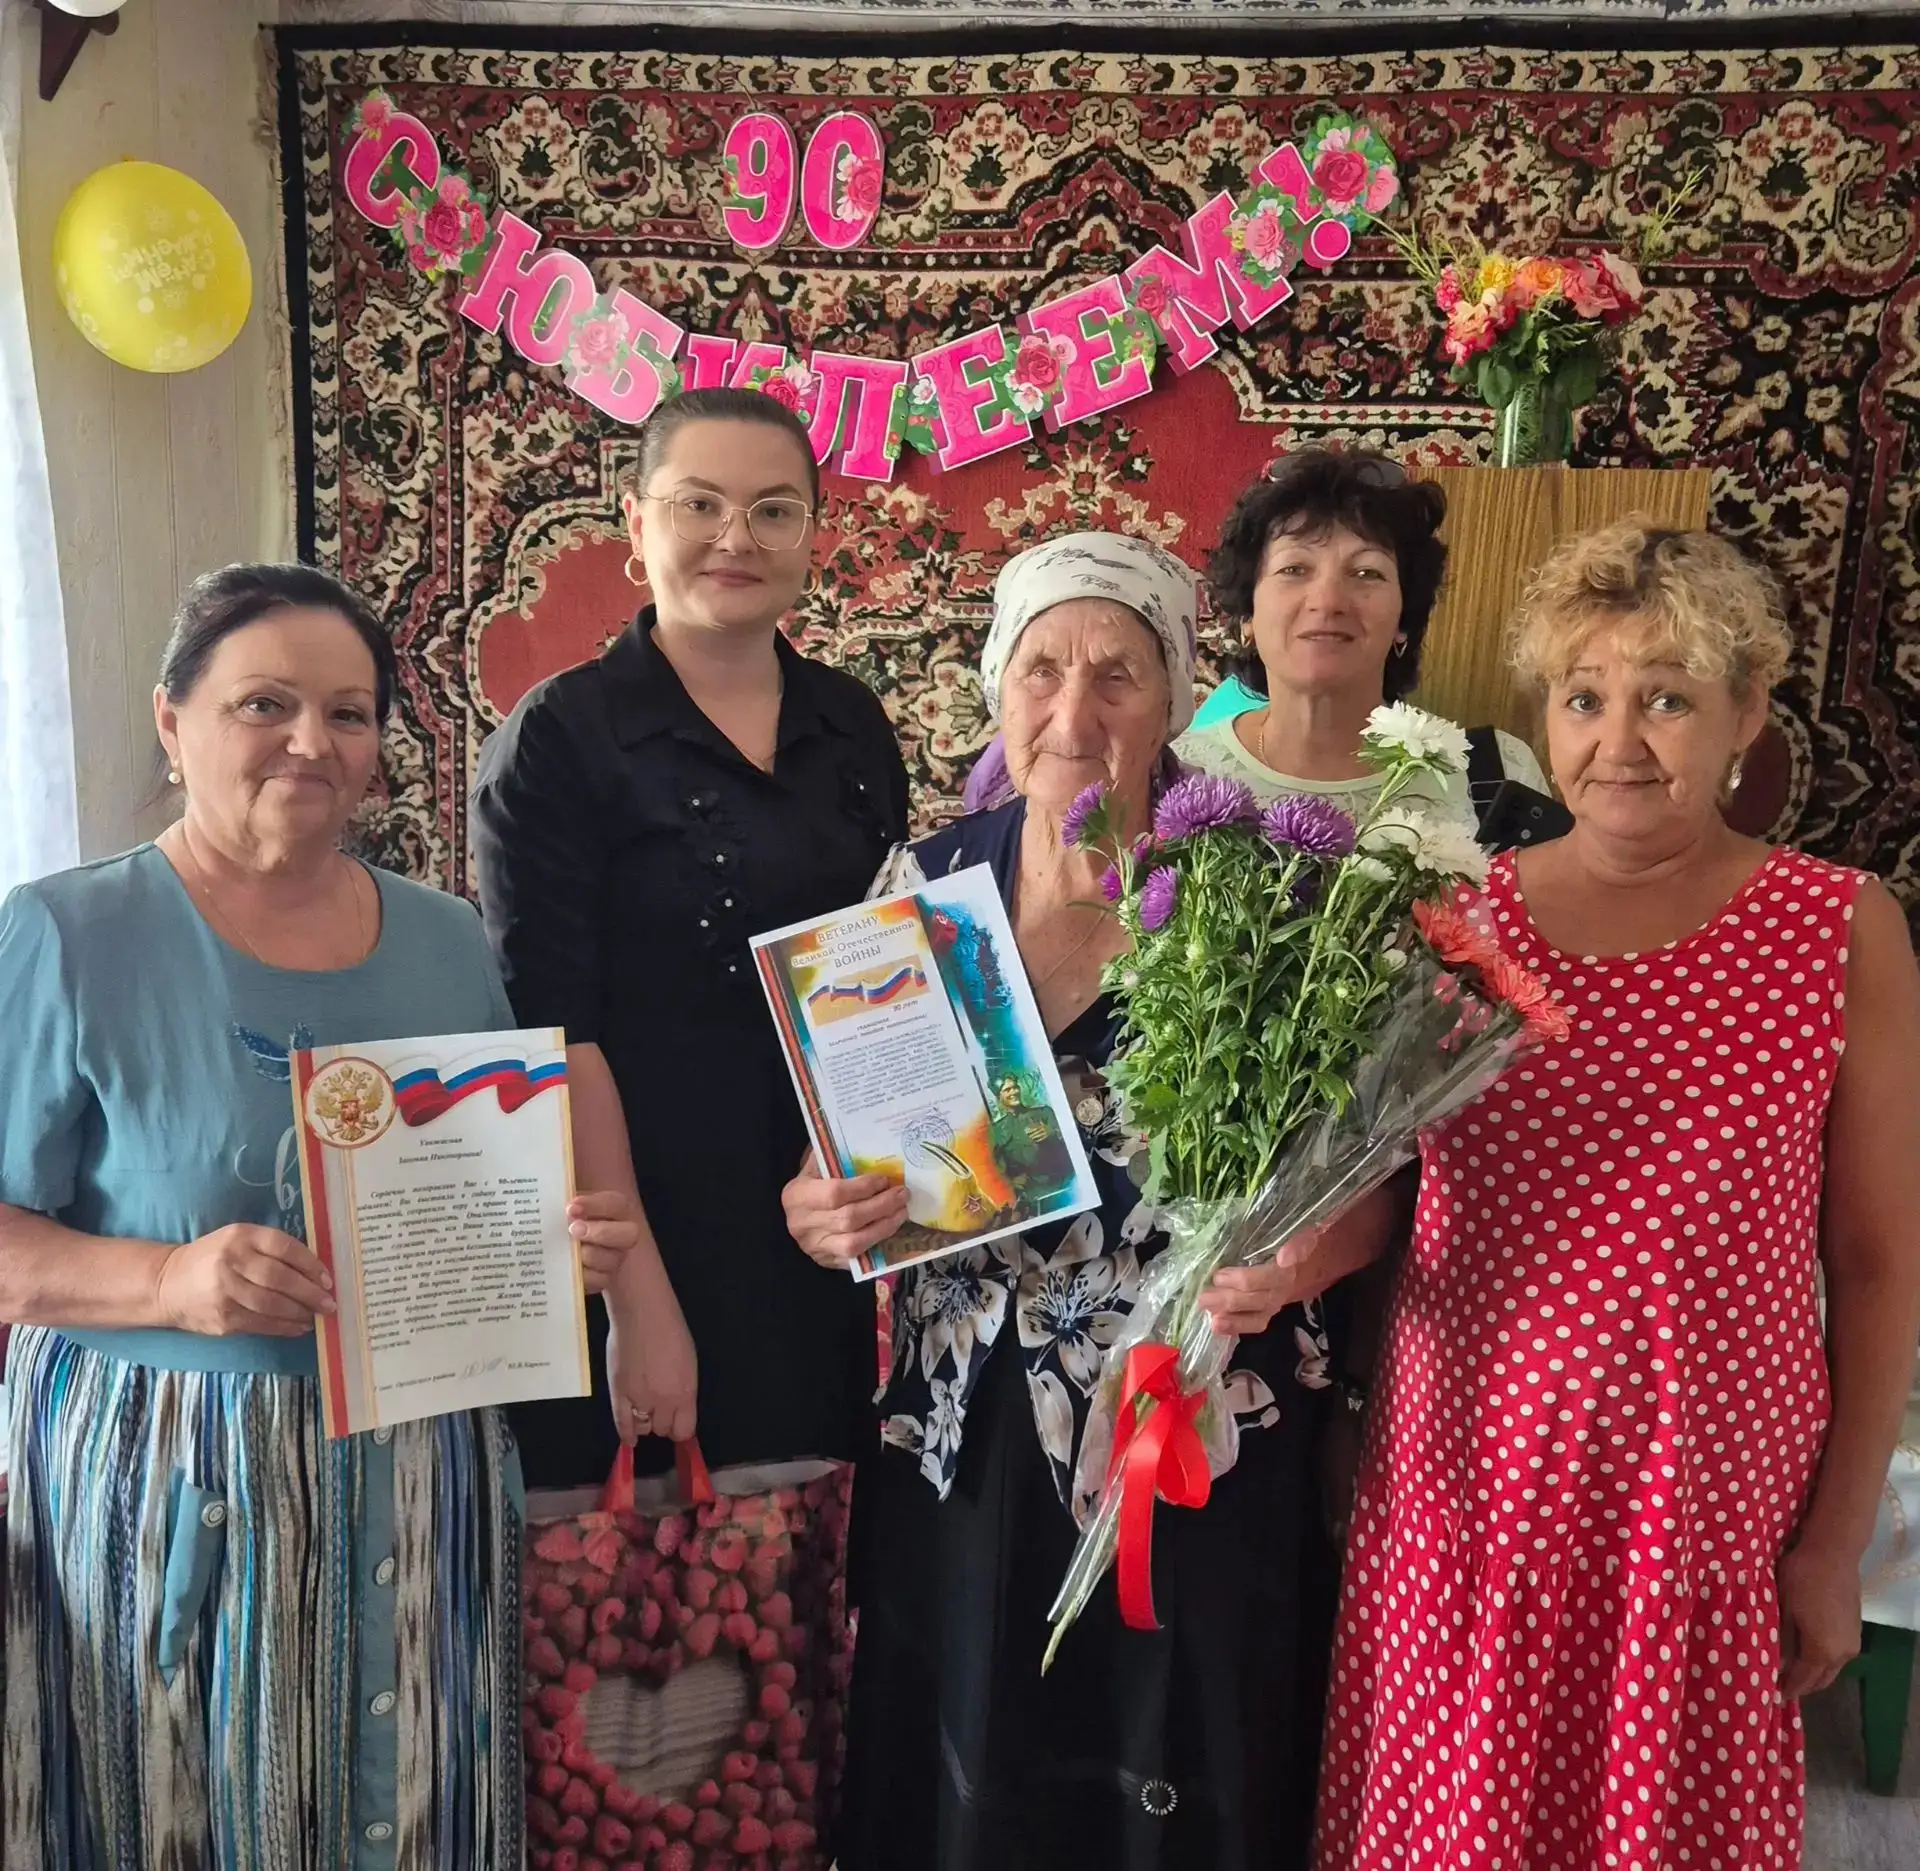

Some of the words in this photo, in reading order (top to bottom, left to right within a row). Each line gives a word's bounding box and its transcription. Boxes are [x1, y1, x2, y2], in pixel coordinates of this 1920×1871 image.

[345, 112, 440, 229] С
[722, 111, 882, 249] 90
[791, 946, 836, 967] Великой
[837, 919, 914, 953] Отечественной
[817, 915, 878, 943] ВЕТЕРАНУ
[834, 944, 882, 969] ВОЙНЫ
